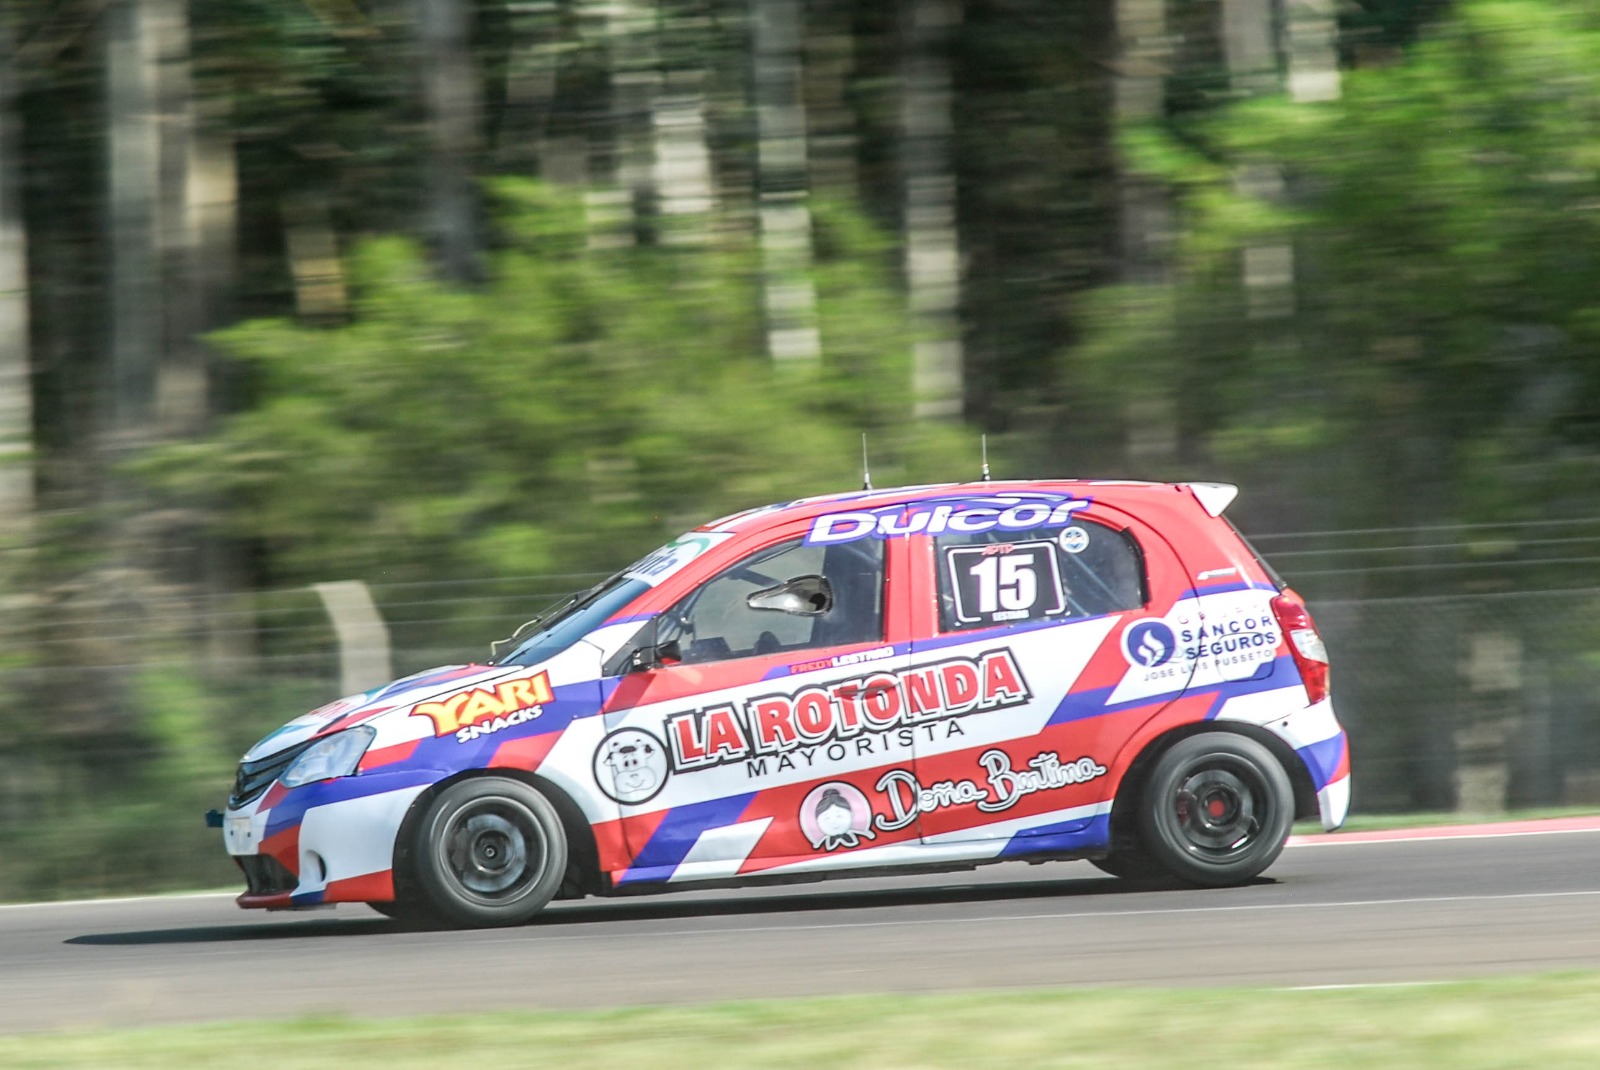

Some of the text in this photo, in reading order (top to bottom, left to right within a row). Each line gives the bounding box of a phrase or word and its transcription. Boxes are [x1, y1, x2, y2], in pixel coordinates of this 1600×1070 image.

[808, 499, 1089, 543] Dulcor
[969, 554, 1037, 613] 15
[1181, 615, 1273, 643] SANCOR
[1185, 631, 1277, 660] SEGUROS
[1143, 667, 1175, 682] JOSE
[1215, 649, 1273, 667] PUSSETO
[409, 670, 555, 738] YARI
[455, 704, 544, 744] SNACKS
[671, 648, 1027, 770] LA ROTONDA
[747, 721, 965, 778] MAYORISTA
[875, 769, 988, 831] Doña
